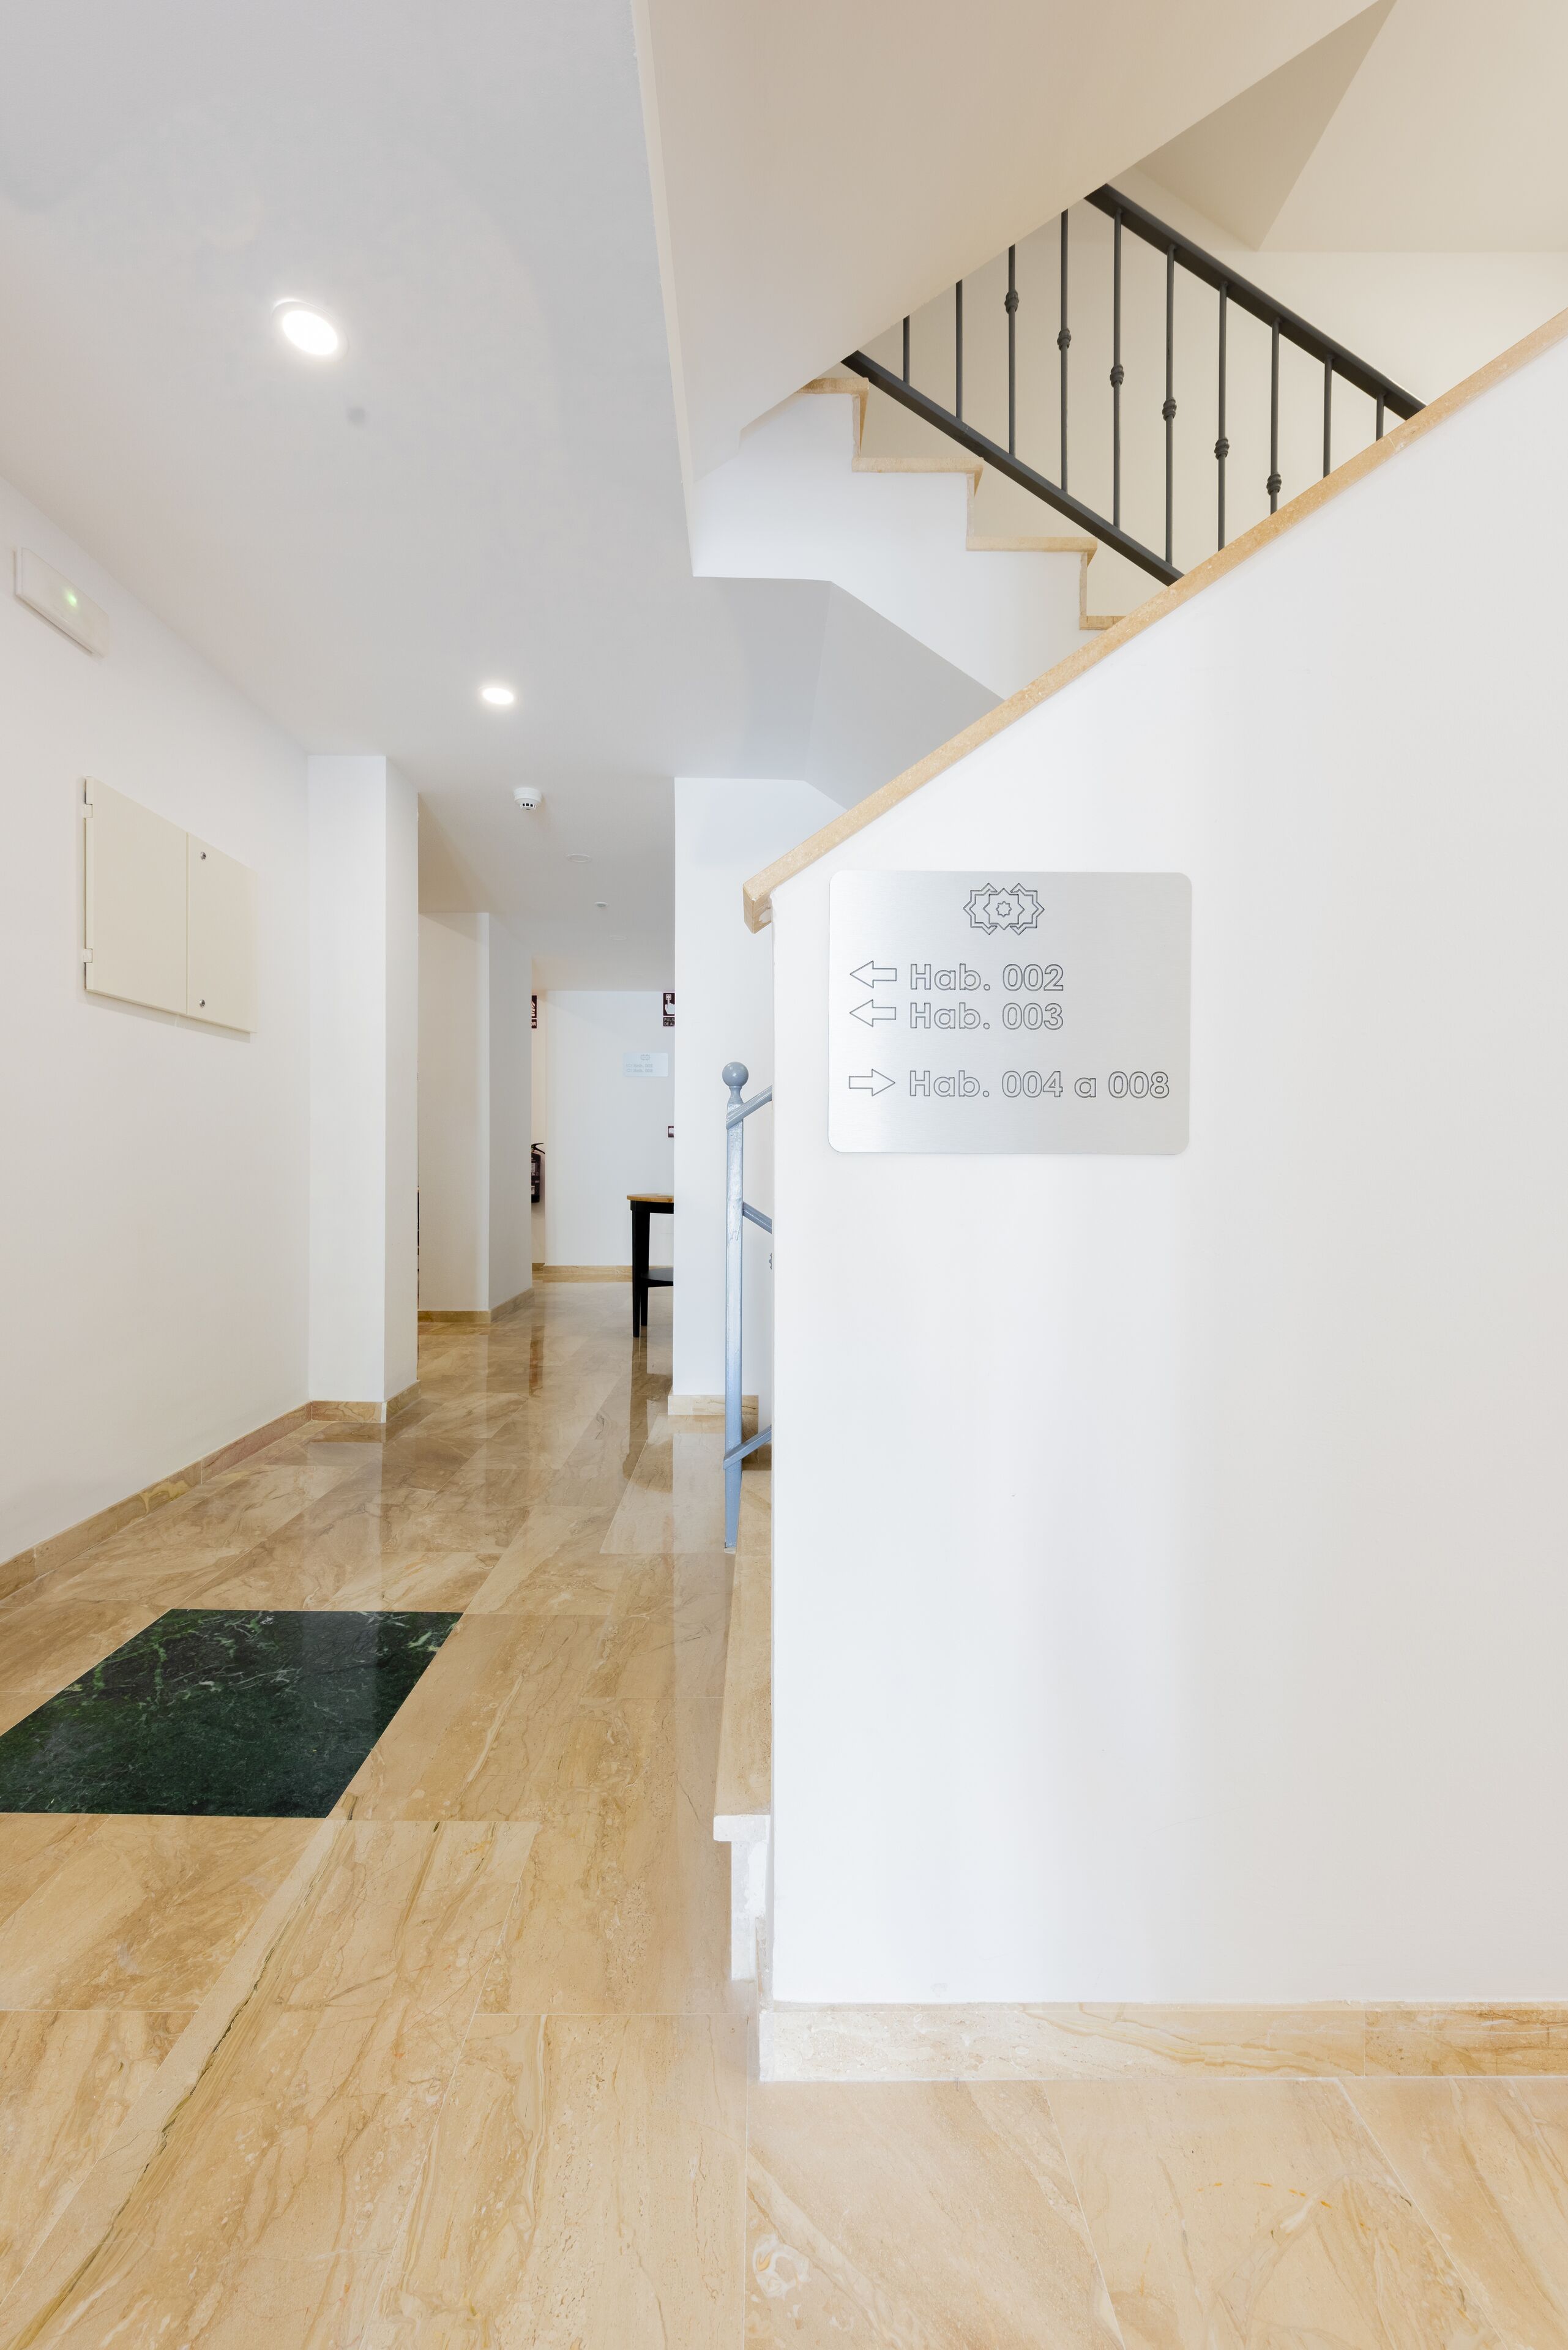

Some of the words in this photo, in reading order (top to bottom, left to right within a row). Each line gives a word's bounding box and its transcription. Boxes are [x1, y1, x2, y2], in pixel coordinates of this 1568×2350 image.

[909, 963, 991, 991] Hab.
[1002, 963, 1064, 991] 002
[909, 1002, 990, 1030] Hab.
[1002, 1002, 1064, 1031] 003
[909, 1070, 990, 1098] Hab.
[1001, 1070, 1064, 1099] 004
[1073, 1077, 1097, 1099] a
[1108, 1071, 1170, 1099] 008
